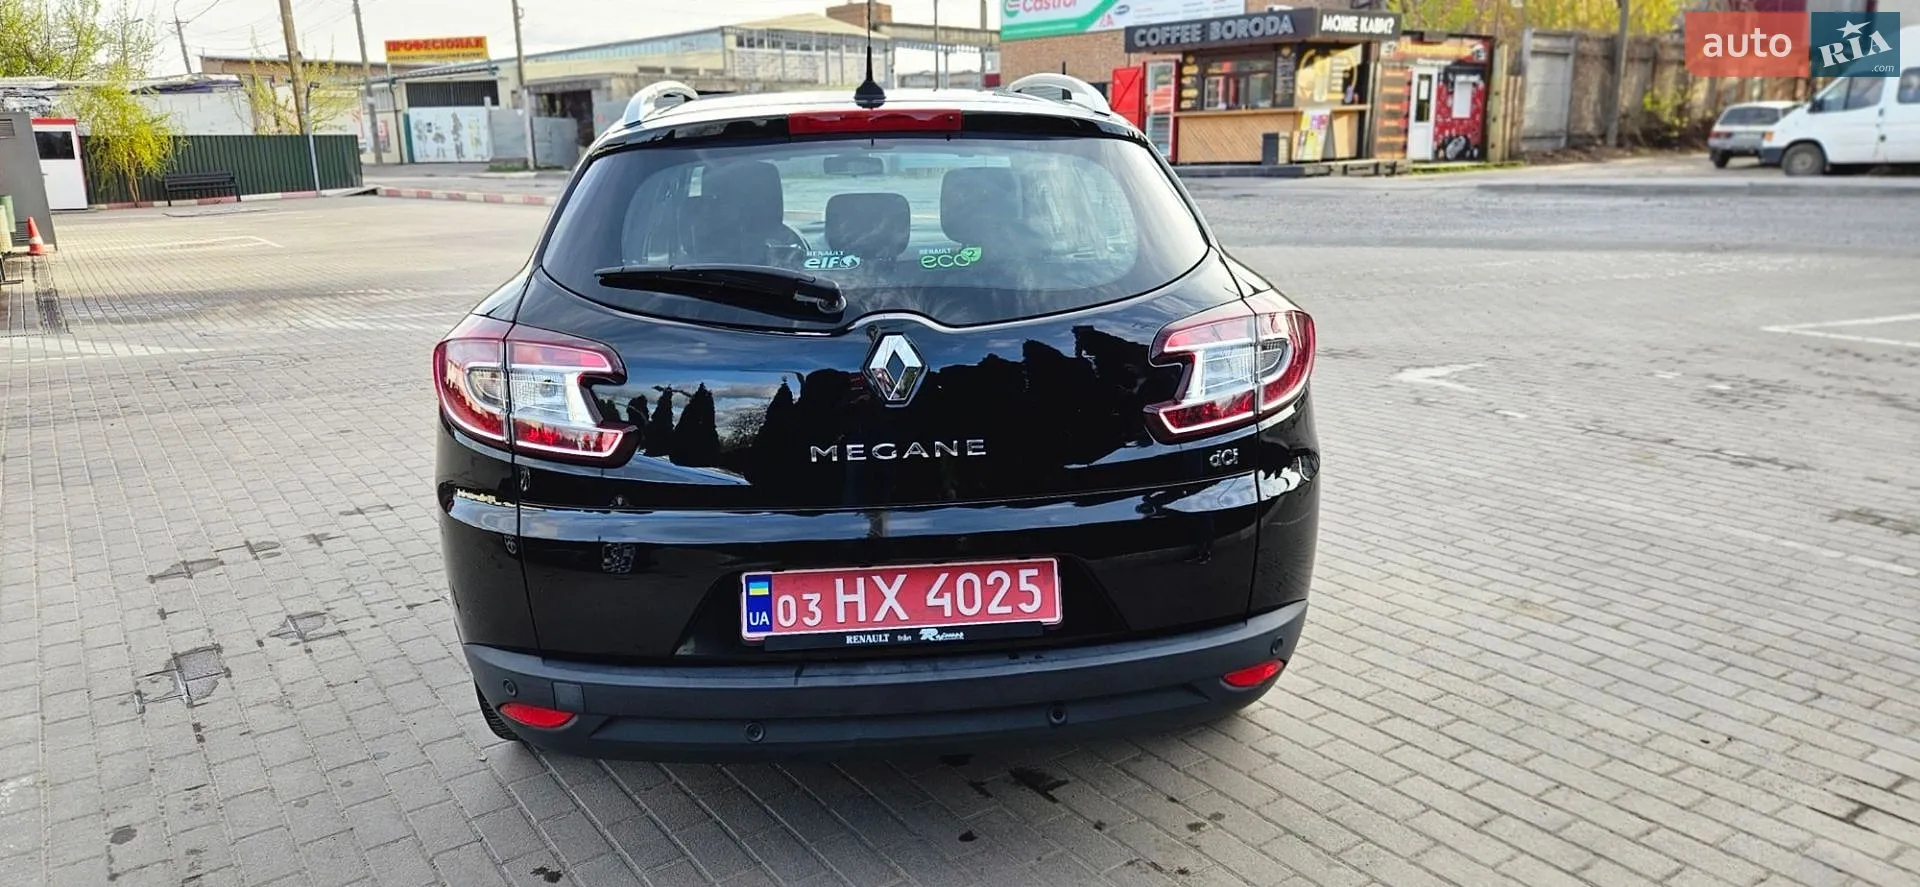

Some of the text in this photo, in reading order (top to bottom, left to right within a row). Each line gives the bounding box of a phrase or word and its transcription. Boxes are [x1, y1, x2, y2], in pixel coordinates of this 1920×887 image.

[1134, 23, 1201, 48] COFFEE
[1209, 14, 1295, 41] BORODA
[810, 439, 987, 463] MEGANE
[777, 568, 1042, 627] 03 HX 4025
[749, 611, 770, 626] UA
[846, 634, 890, 644] RENAULT
